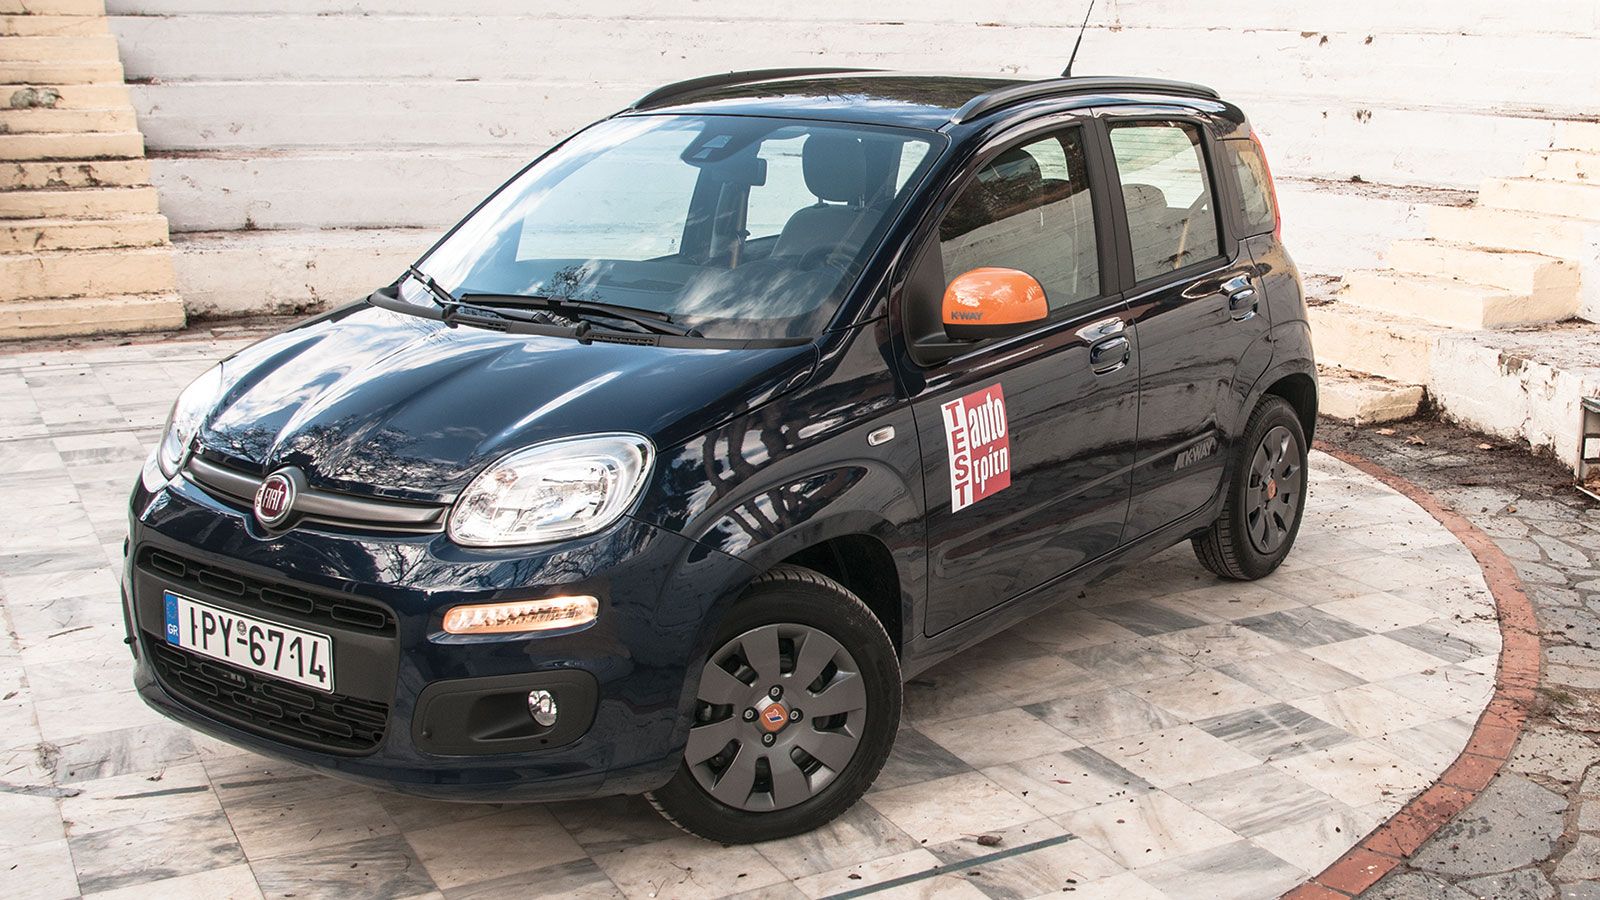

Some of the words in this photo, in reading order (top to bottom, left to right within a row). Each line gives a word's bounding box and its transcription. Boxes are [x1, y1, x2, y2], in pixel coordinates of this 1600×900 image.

[968, 392, 1006, 450] auto
[945, 401, 969, 506] TEST
[262, 484, 284, 510] FIAT
[167, 623, 179, 637] GR
